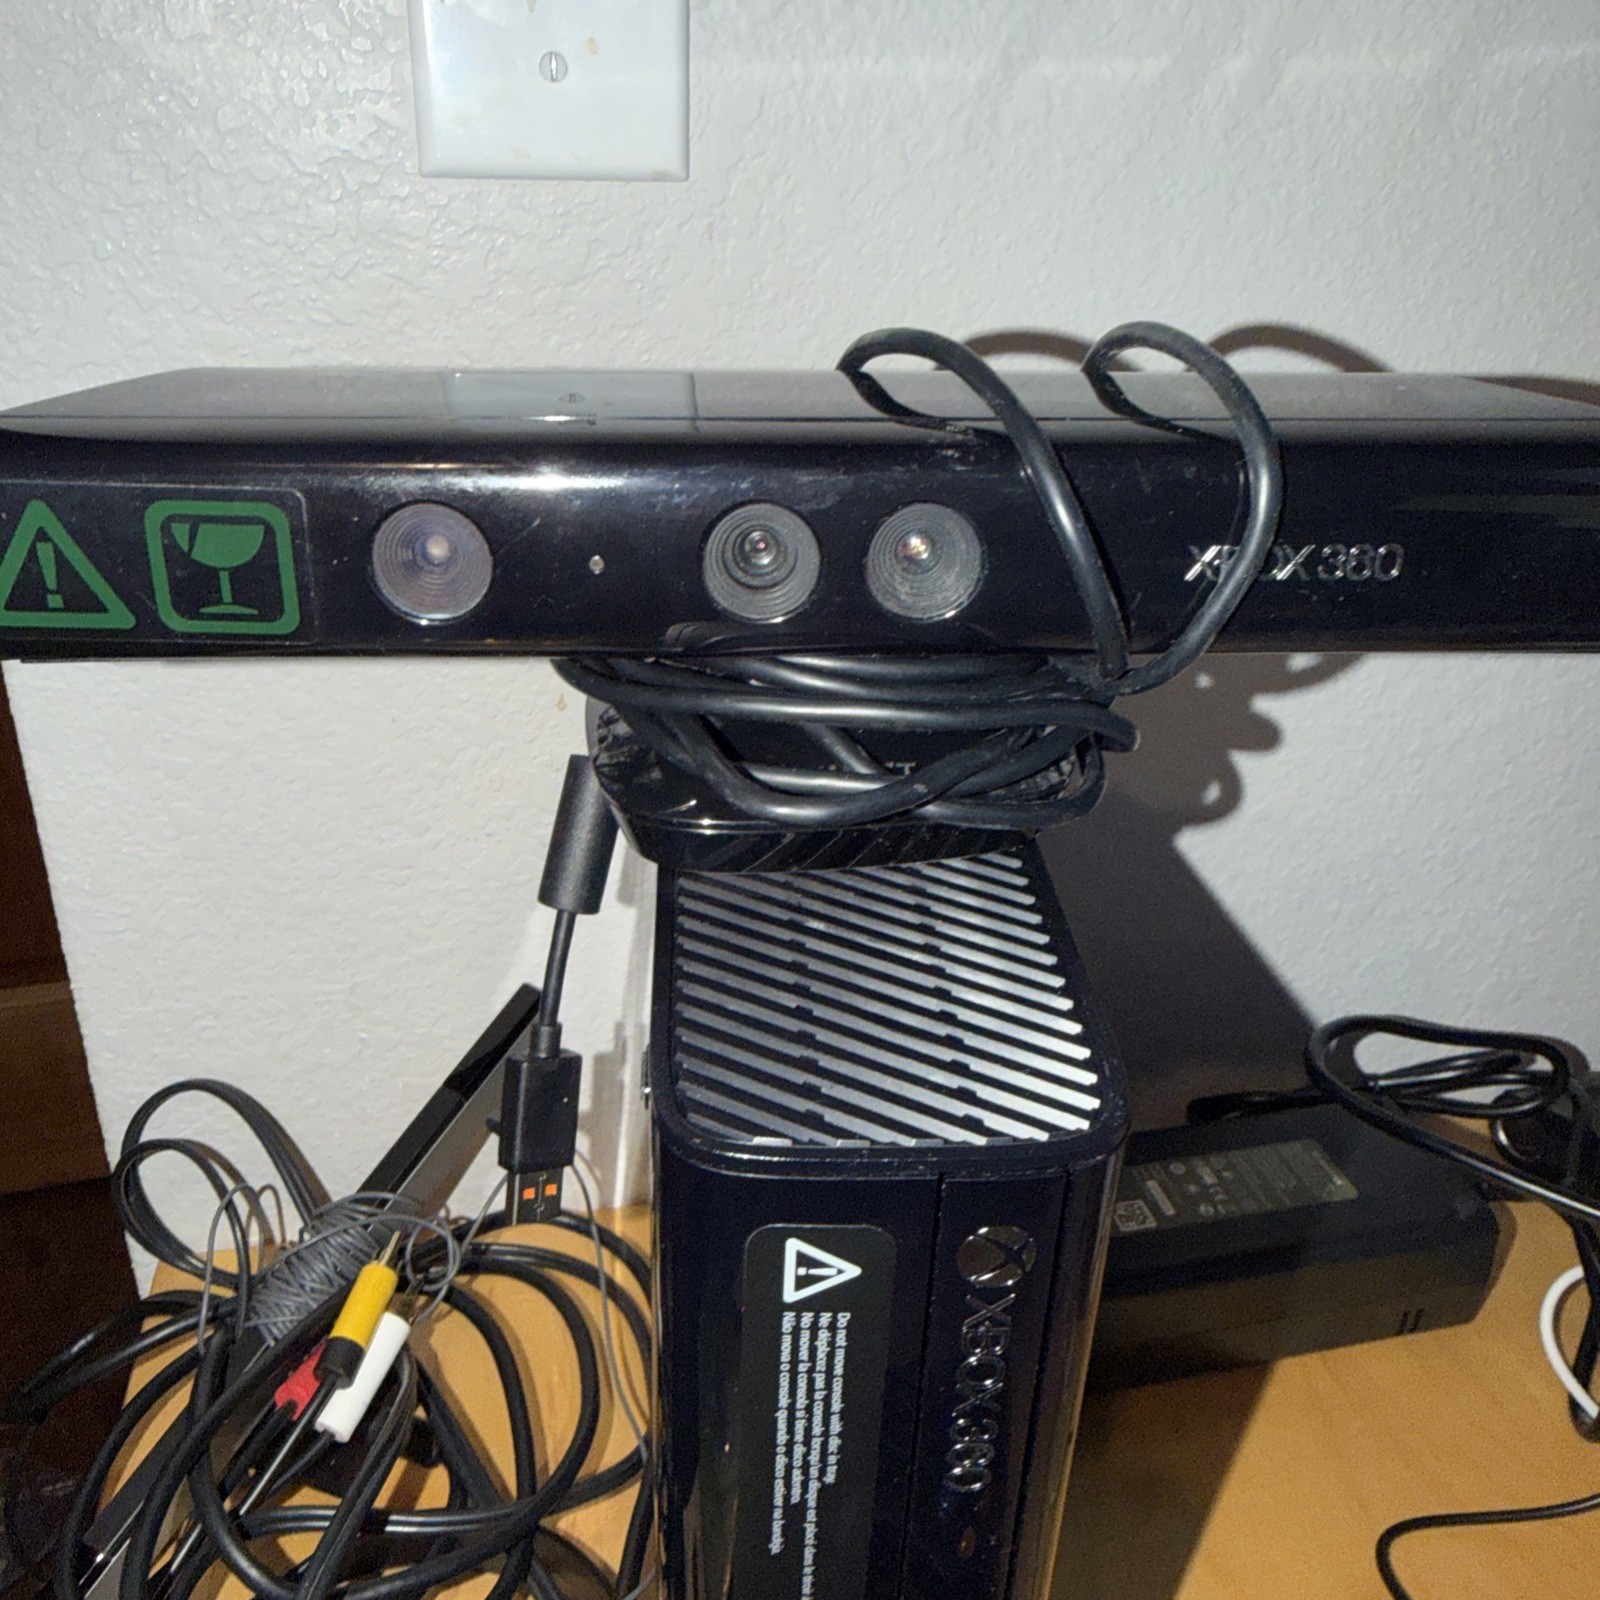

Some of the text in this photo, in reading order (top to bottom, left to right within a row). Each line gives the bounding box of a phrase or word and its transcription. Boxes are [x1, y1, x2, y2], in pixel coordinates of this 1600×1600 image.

[1317, 543, 1404, 581] 360
[782, 1312, 796, 1333] Não
[800, 1312, 815, 1328] No
[818, 1312, 833, 1328] Ne
[837, 1312, 851, 1328] Do
[781, 1335, 792, 1362] mova
[798, 1330, 810, 1361] mover
[835, 1329, 847, 1347] not
[814, 1329, 832, 1372] déplacez
[834, 1349, 845, 1375] move
[780, 1363, 790, 1371] o
[798, 1363, 812, 1371] la
[778, 1372, 792, 1408] console
[795, 1373, 810, 1409] consola
[812, 1373, 826, 1390] pas
[944, 1292, 1016, 1493] XBOX 360
[814, 1391, 828, 1400] la
[831, 1377, 845, 1412] console
[795, 1410, 808, 1418] si
[811, 1401, 825, 1436] console
[829, 1414, 843, 1434] with
[774, 1409, 788, 1445] quando
[794, 1419, 808, 1442] tiene
[793, 1444, 807, 1467] disco
[828, 1436, 842, 1454] disc
[775, 1455, 788, 1478] disco
[827, 1455, 841, 1464] in
[805, 1480, 821, 1508] disque
[806, 1509, 818, 1522] est
